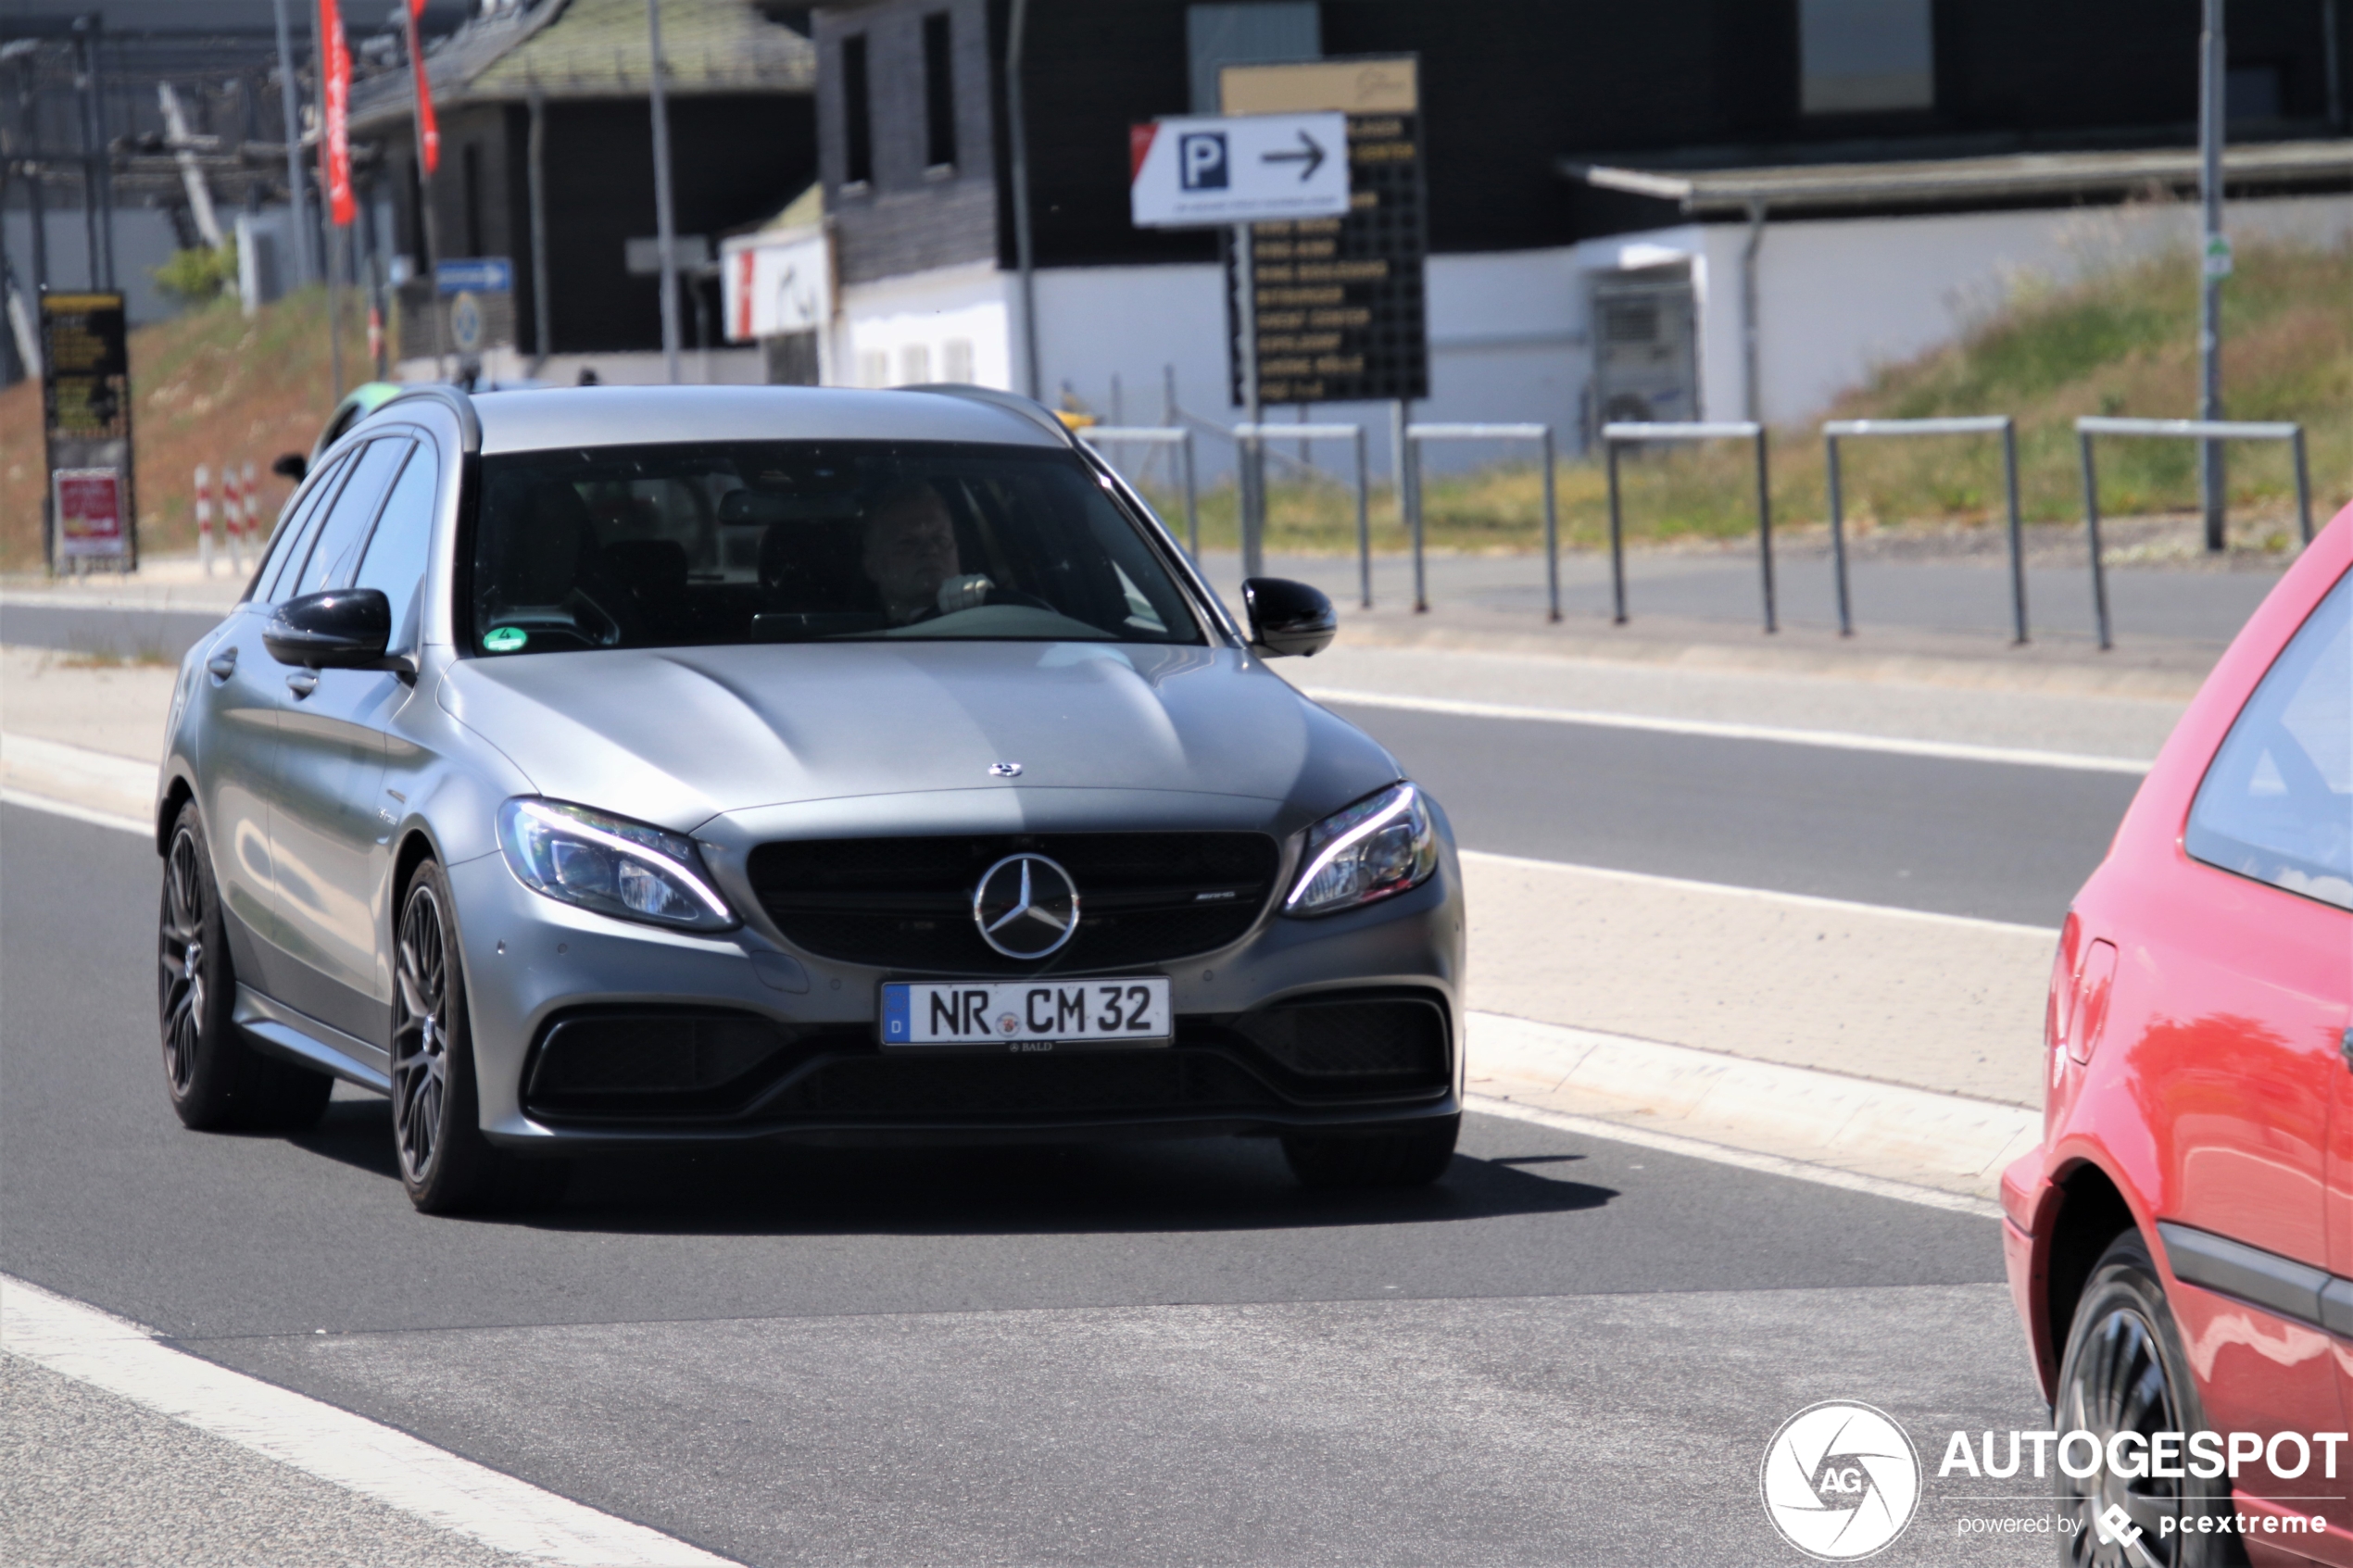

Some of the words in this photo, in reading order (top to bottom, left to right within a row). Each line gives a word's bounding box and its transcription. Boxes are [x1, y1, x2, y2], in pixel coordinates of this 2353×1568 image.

[1187, 137, 1222, 186] P
[498, 628, 511, 639] 4
[930, 990, 991, 1035] NR
[1026, 987, 1085, 1034] CM
[1097, 985, 1151, 1032] 32
[891, 1021, 901, 1033] D
[1022, 1042, 1052, 1052] BALD
